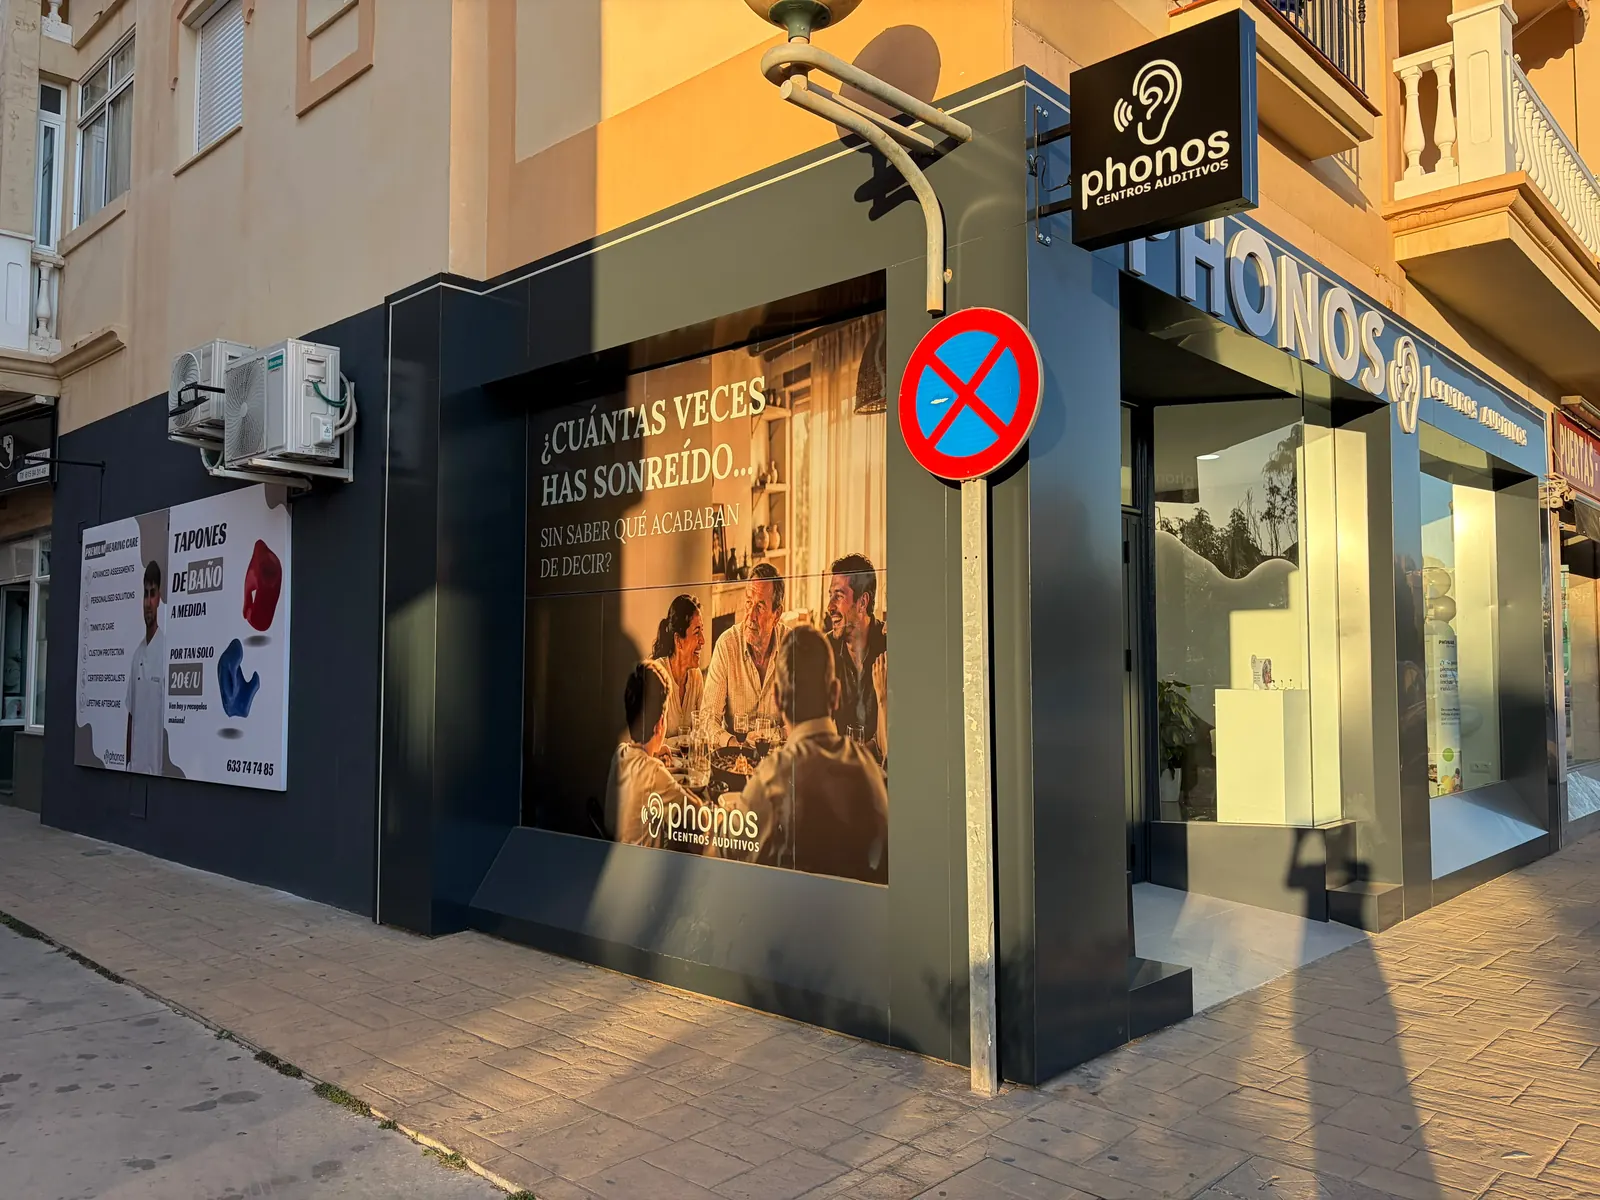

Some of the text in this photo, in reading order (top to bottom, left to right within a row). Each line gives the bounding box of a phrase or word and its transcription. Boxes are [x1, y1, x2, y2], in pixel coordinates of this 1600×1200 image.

[1081, 130, 1230, 211] phonos
[1096, 158, 1229, 206] CENTROS AUDITIVOS
[540, 376, 767, 465] ¿CUÁNTAS VECES
[1559, 423, 1595, 488] PUERTAS
[541, 438, 753, 506] HAS SONREÍDO...
[174, 522, 227, 554] TAPONES
[540, 503, 740, 548] SIN SABER QUÉ ACABABAN
[105, 540, 125, 553] HEARING
[126, 537, 139, 548] CARE
[171, 560, 223, 593] DE BAÑO
[540, 553, 612, 578] DE DECIR?
[171, 602, 207, 619] A MEDIDA
[170, 646, 214, 660] POR TAN SOLO
[170, 671, 201, 689] 20€/U
[226, 759, 274, 776] 633 74 74 85
[667, 795, 758, 841] phonos
[672, 831, 760, 852] CENTROS AUDITIVOS
